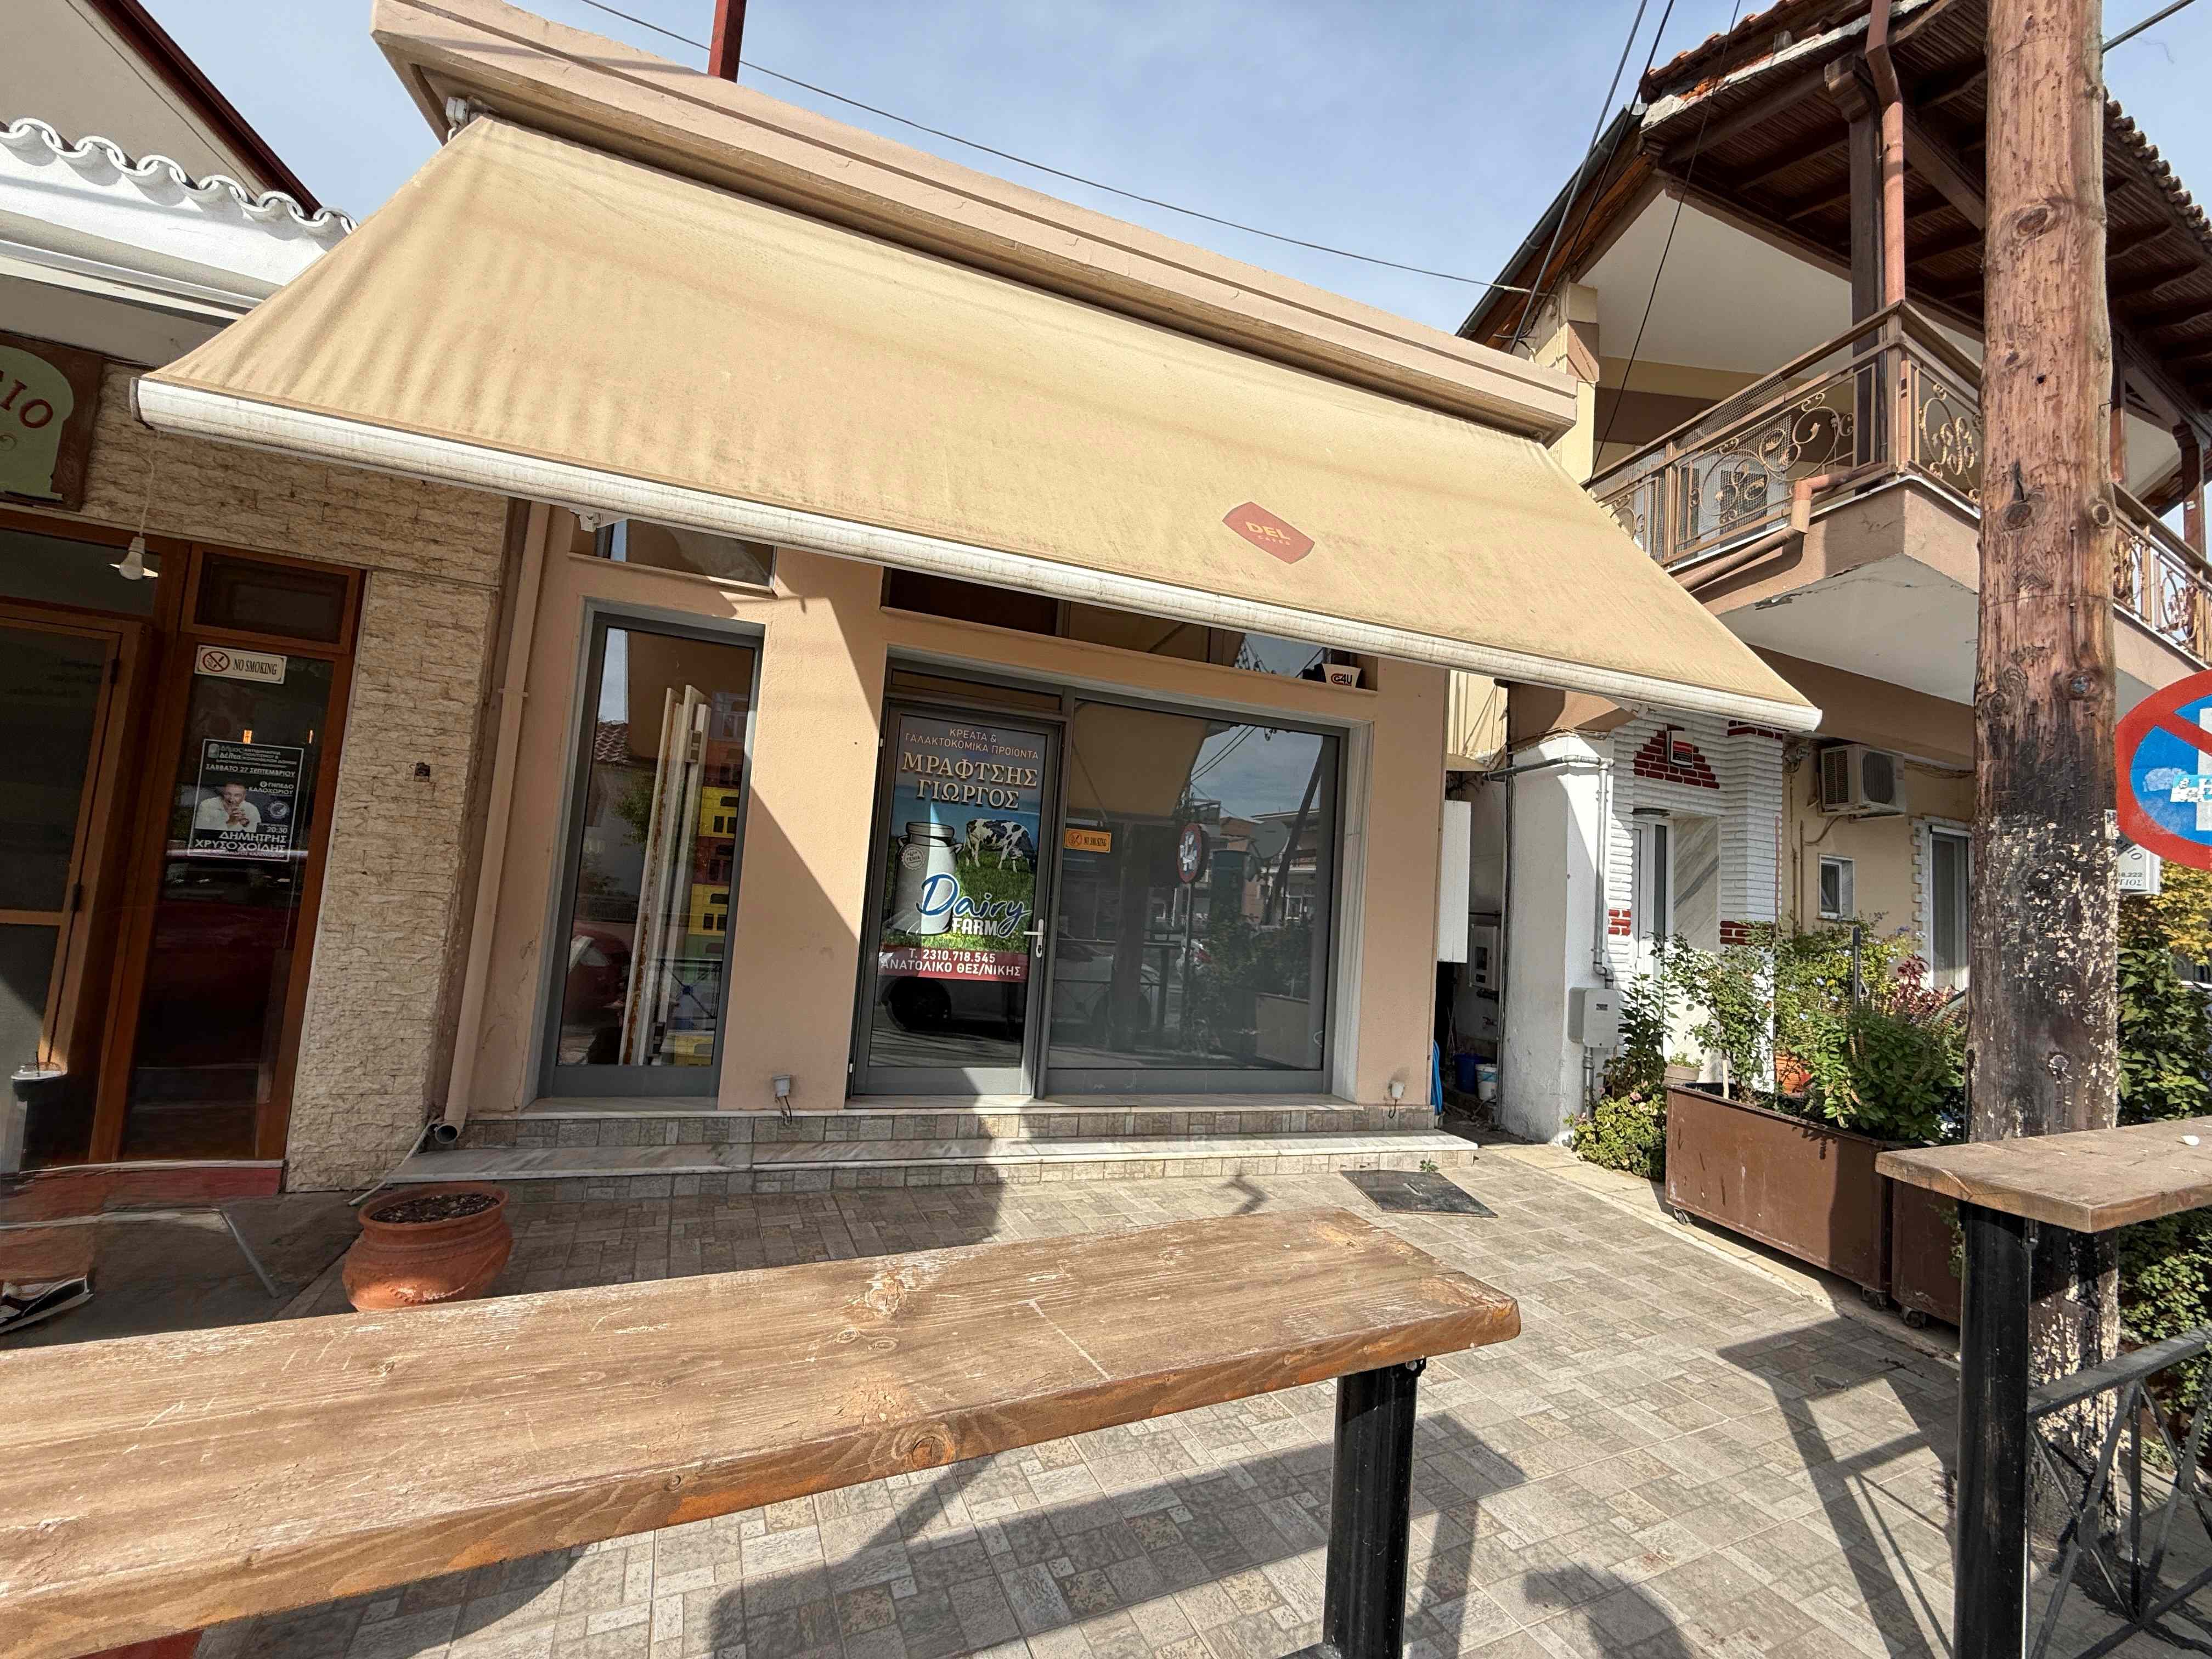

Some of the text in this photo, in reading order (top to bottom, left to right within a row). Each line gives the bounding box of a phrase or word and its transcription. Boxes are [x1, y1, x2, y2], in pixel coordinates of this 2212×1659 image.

[1245, 522, 1291, 540] DEL
[233, 659, 277, 675] NO SMOKING
[950, 728, 997, 743] ΚΡΕΑΤΑ &
[905, 733, 1039, 760] ΓΑΛΑΚΤΟΚΟΜΙΚΑ ΠΡΟΪΟΝΤΑ
[206, 764, 238, 772] ΣΑΒΒΑΤΟ
[250, 768, 296, 777] ΣΕΠΤΕΜΒΡΙΟΥ
[901, 752, 1038, 787] ΜΡΑΦΤΣΗΣ
[249, 787, 294, 795] ΚΑΛΟΧΩΡΙΟΥ
[917, 779, 1019, 809] ΓΙΩΡΓΟΣ
[195, 839, 286, 852] ΧΡΥΣΟΧΟΪΔΗΣ
[219, 831, 287, 843] ΔΗΜΗΤΡΗΣ
[916, 873, 1032, 938] Dairy
[952, 916, 998, 936] FARM
[922, 950, 996, 963] 2310.718.545
[881, 958, 1021, 977] ΑΝΑΤΟΛΙΚΟ ΘΕΣ/ΝΙΚΗΣ
